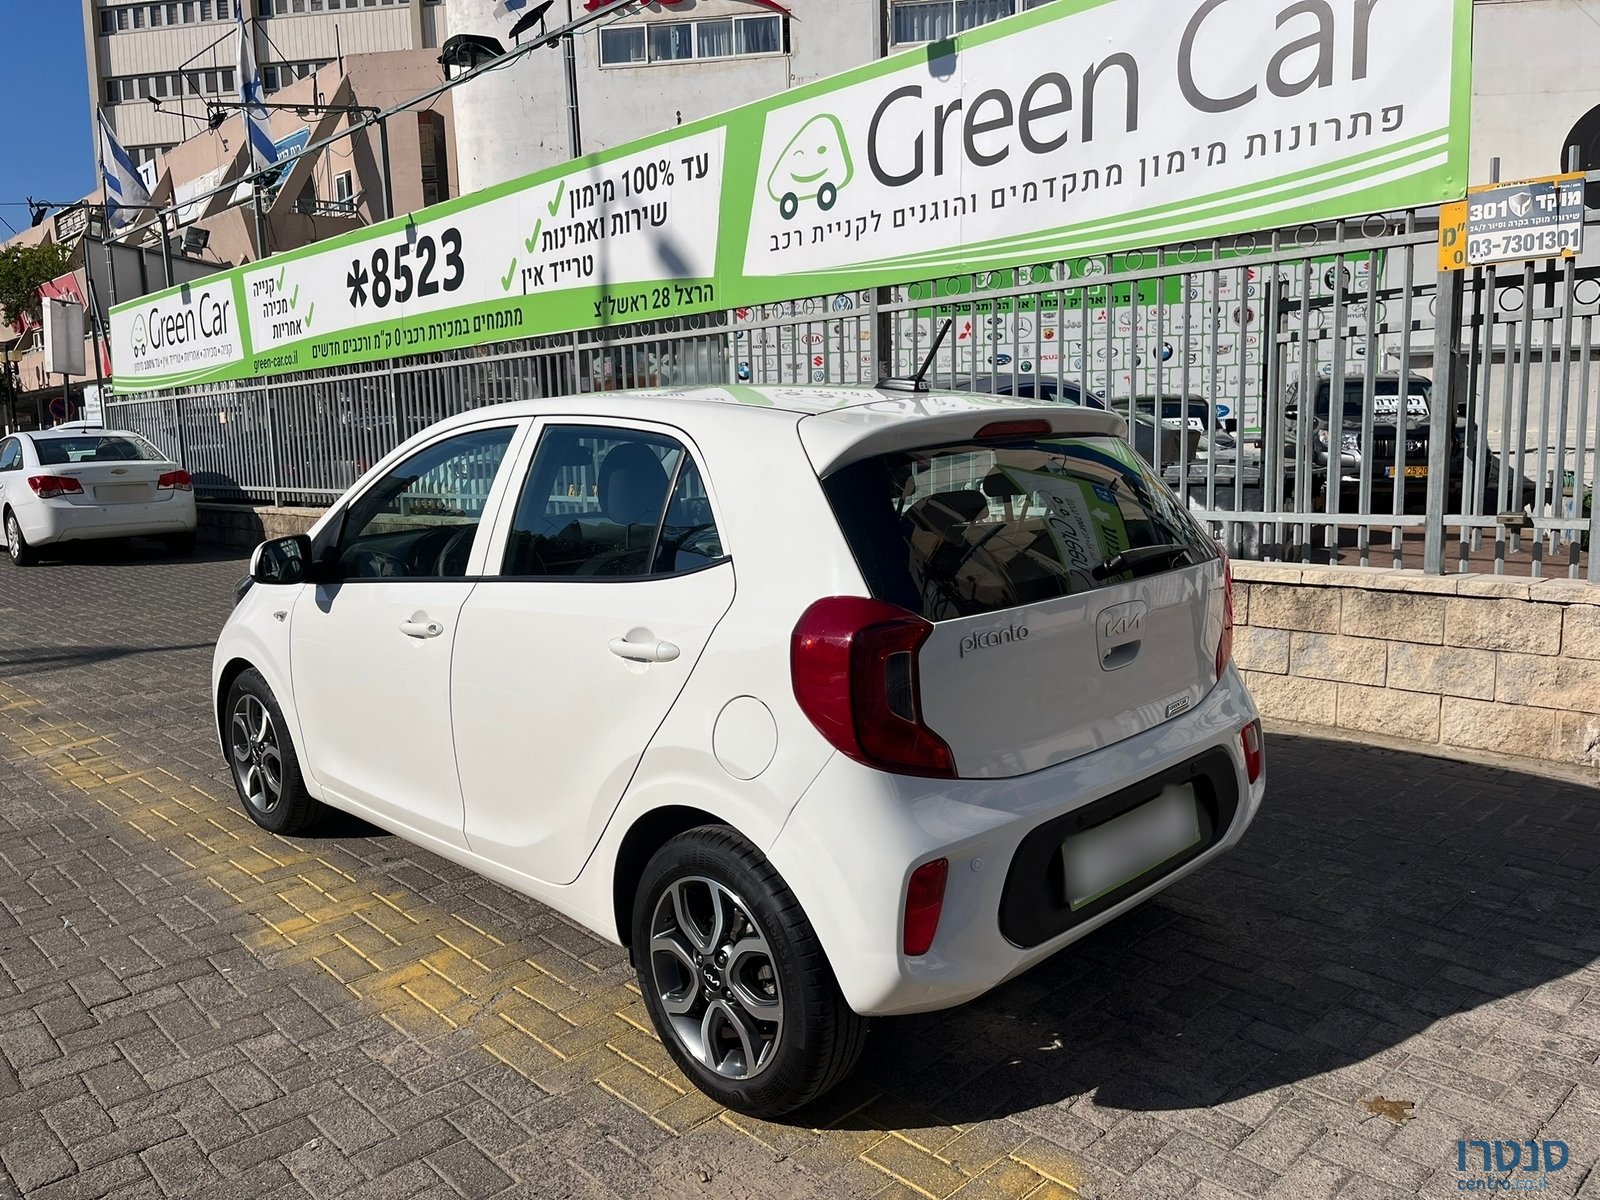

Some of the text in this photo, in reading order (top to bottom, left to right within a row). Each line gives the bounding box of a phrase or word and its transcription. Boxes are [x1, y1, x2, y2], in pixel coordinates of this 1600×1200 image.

[867, 0, 1378, 187] Green Car
[569, 153, 709, 218] עד 100% מימון
[770, 104, 1404, 251] פתרונות מימון מתקדמים והוגנים לקניית רכב
[1470, 201, 1507, 222] 301
[1531, 216, 1550, 225] מוקד
[542, 202, 667, 252] שירות ואמינות
[1470, 224, 1486, 232] 24/7
[1508, 219, 1529, 228] בקרה
[1469, 228, 1579, 257] 03-7301301
[522, 255, 593, 295] טרייד אין
[253, 278, 274, 298] קנייה
[652, 287, 670, 309] 28
[674, 283, 714, 306] הרצל
[263, 298, 288, 318] מכירה
[148, 292, 230, 349] Green Car
[272, 319, 302, 339] אחריות
[428, 318, 470, 341] במכירת
[474, 306, 523, 333] מתמחים
[343, 336, 371, 354] ורכבים
[395, 328, 401, 346] 0
[403, 327, 426, 345] רכבי
[312, 341, 340, 359] חדשים
[253, 350, 299, 373] green-car.co.il
[959, 624, 1029, 659] picanto
